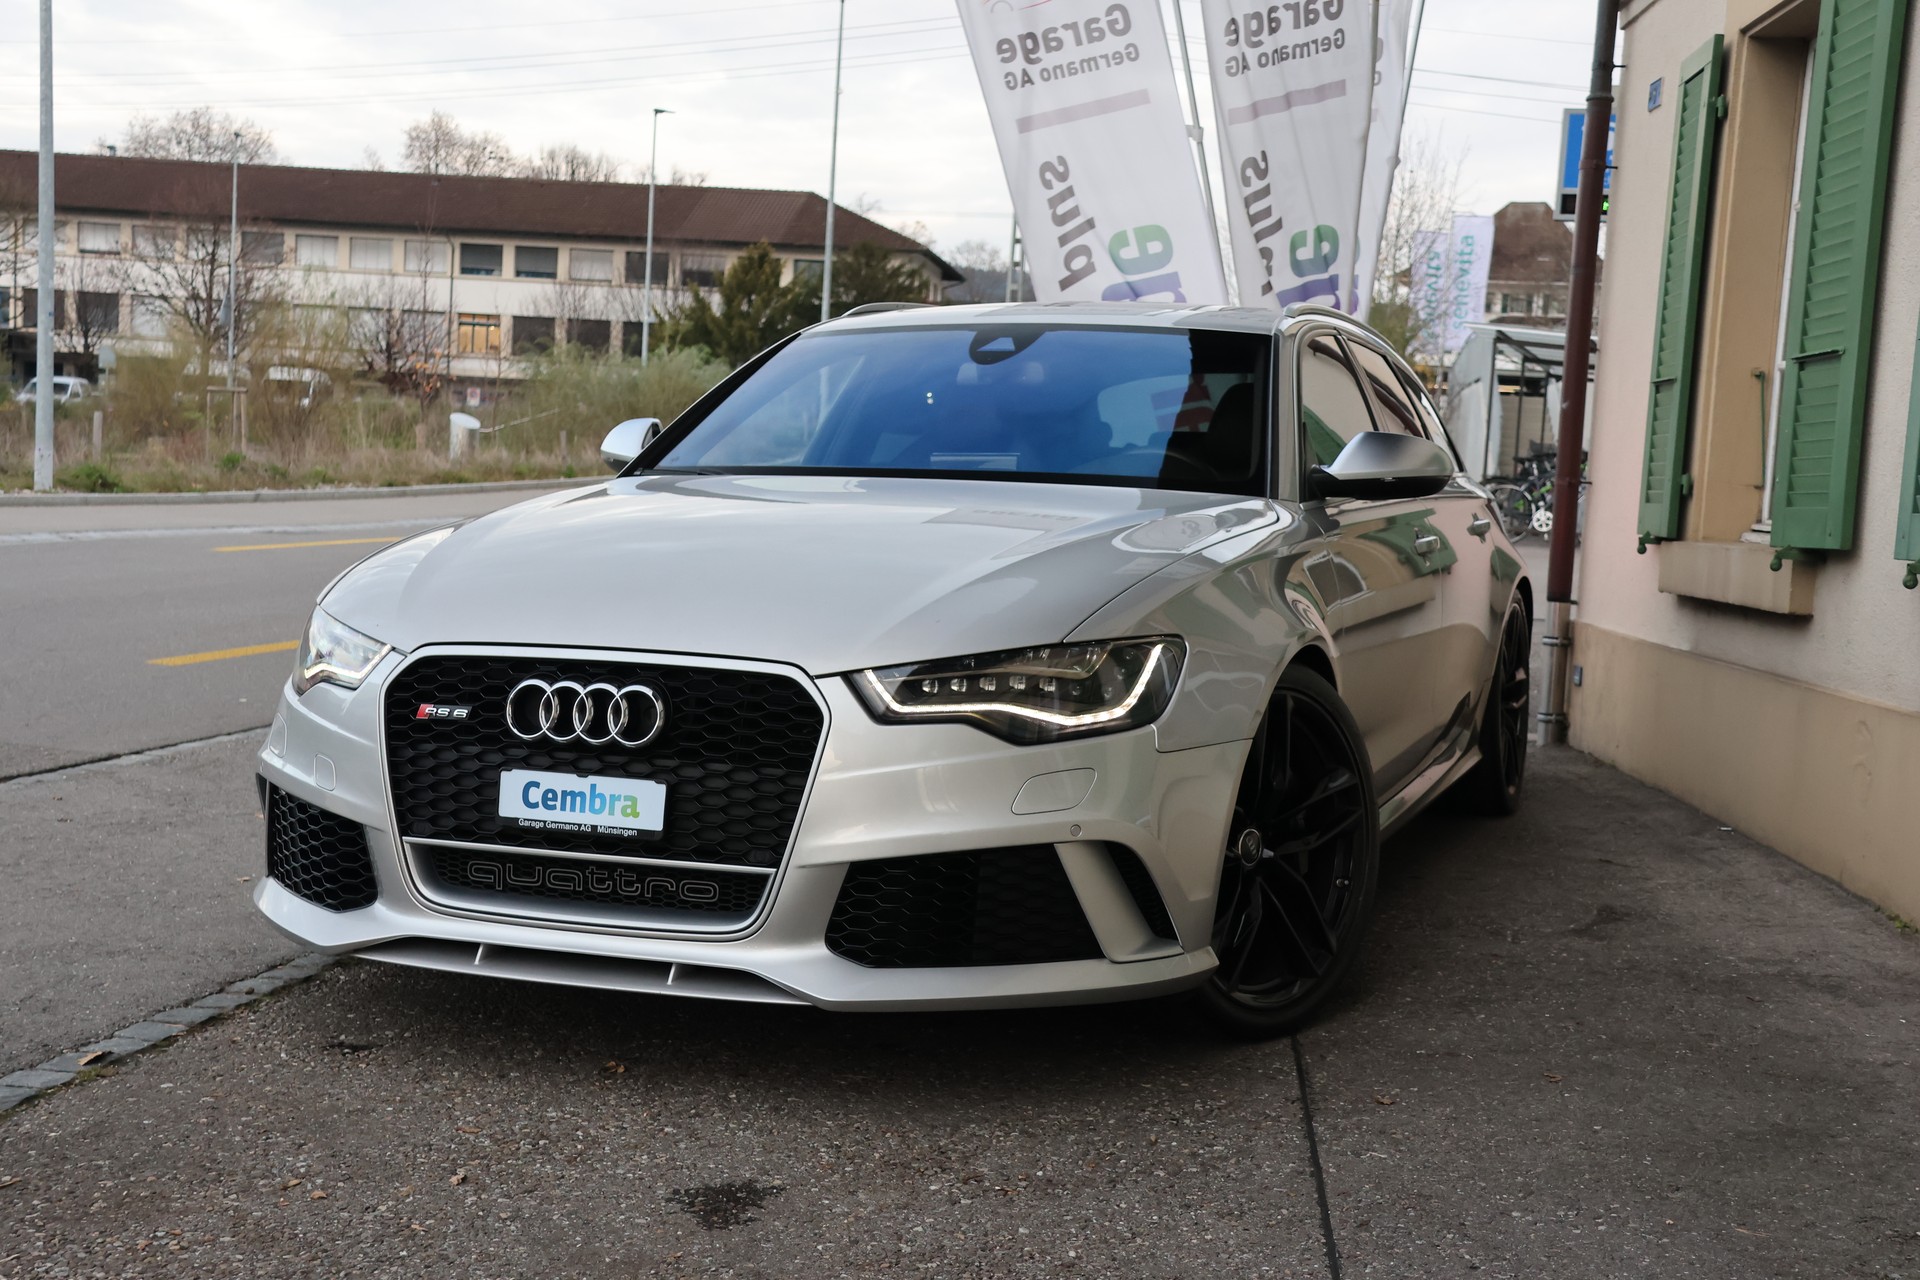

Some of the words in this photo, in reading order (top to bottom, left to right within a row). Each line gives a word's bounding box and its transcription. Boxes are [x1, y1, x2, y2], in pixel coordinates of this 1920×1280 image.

[1452, 234, 1475, 330] senevita
[522, 780, 640, 819] Cembra
[518, 818, 544, 829] Garage
[545, 820, 579, 831] Germano
[580, 824, 592, 832] AG
[597, 825, 638, 837] Münsingen
[467, 860, 719, 902] quattro
